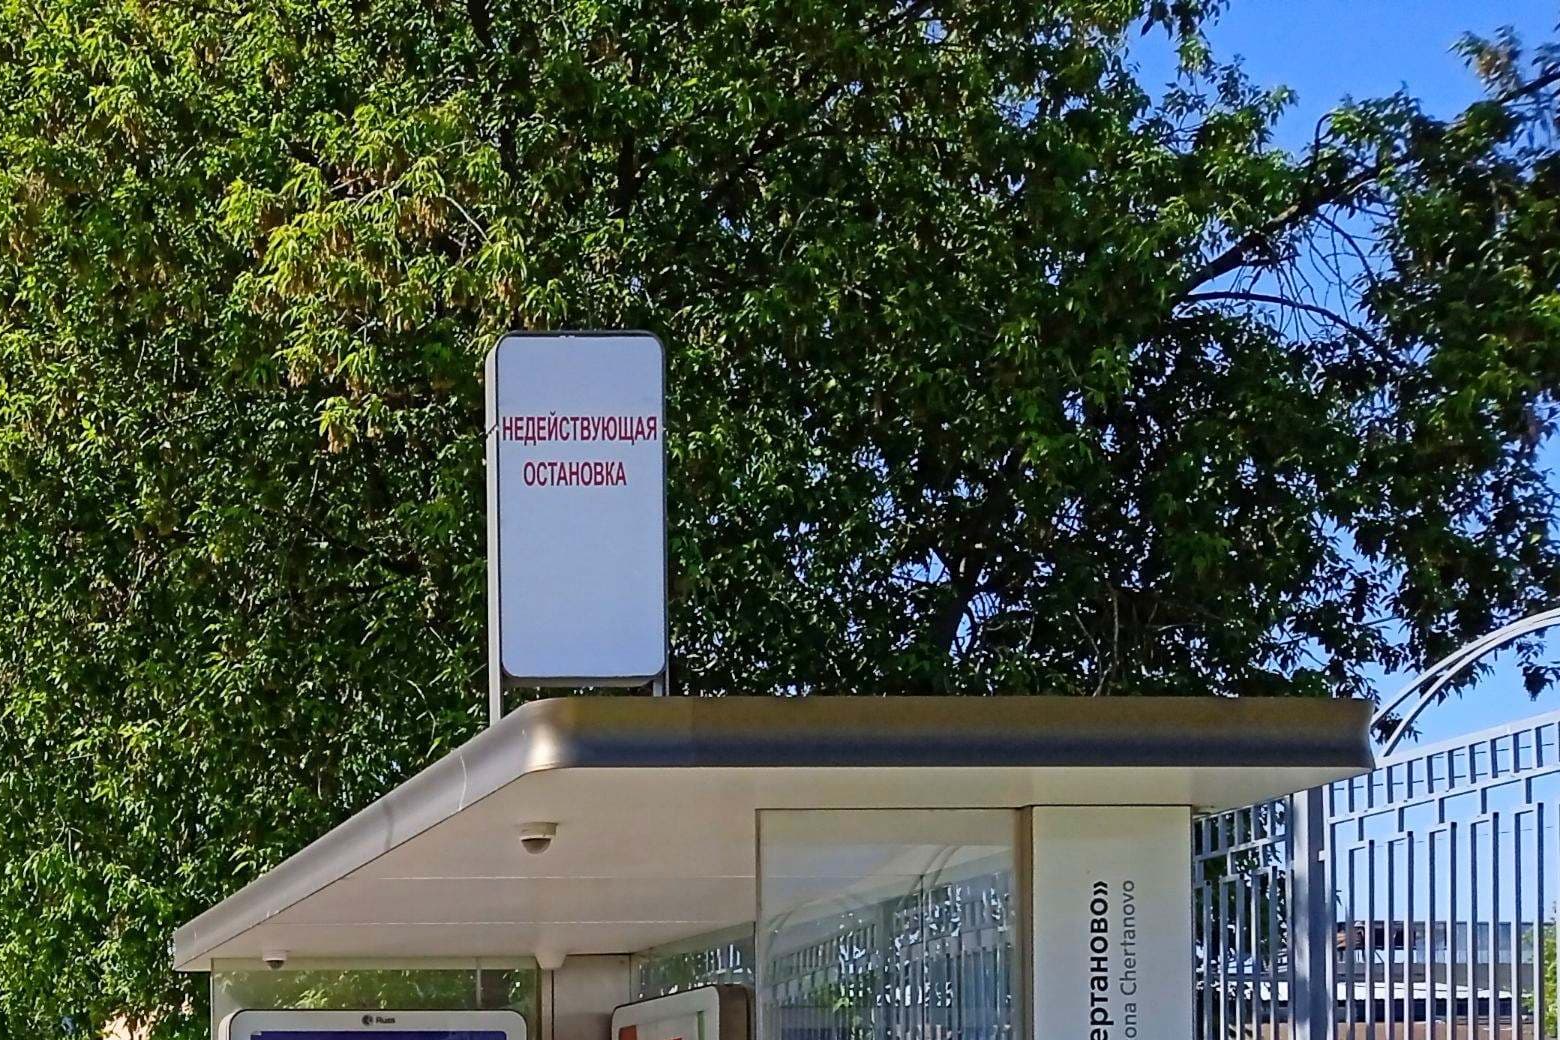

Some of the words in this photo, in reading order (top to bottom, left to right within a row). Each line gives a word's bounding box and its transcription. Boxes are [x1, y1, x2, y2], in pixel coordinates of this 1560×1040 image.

[502, 410, 657, 446] НЕДЕЙСТВУЮЩАЯ
[523, 461, 627, 486] ОСТАНОВКА
[1119, 880, 1137, 996] Chertanovo
